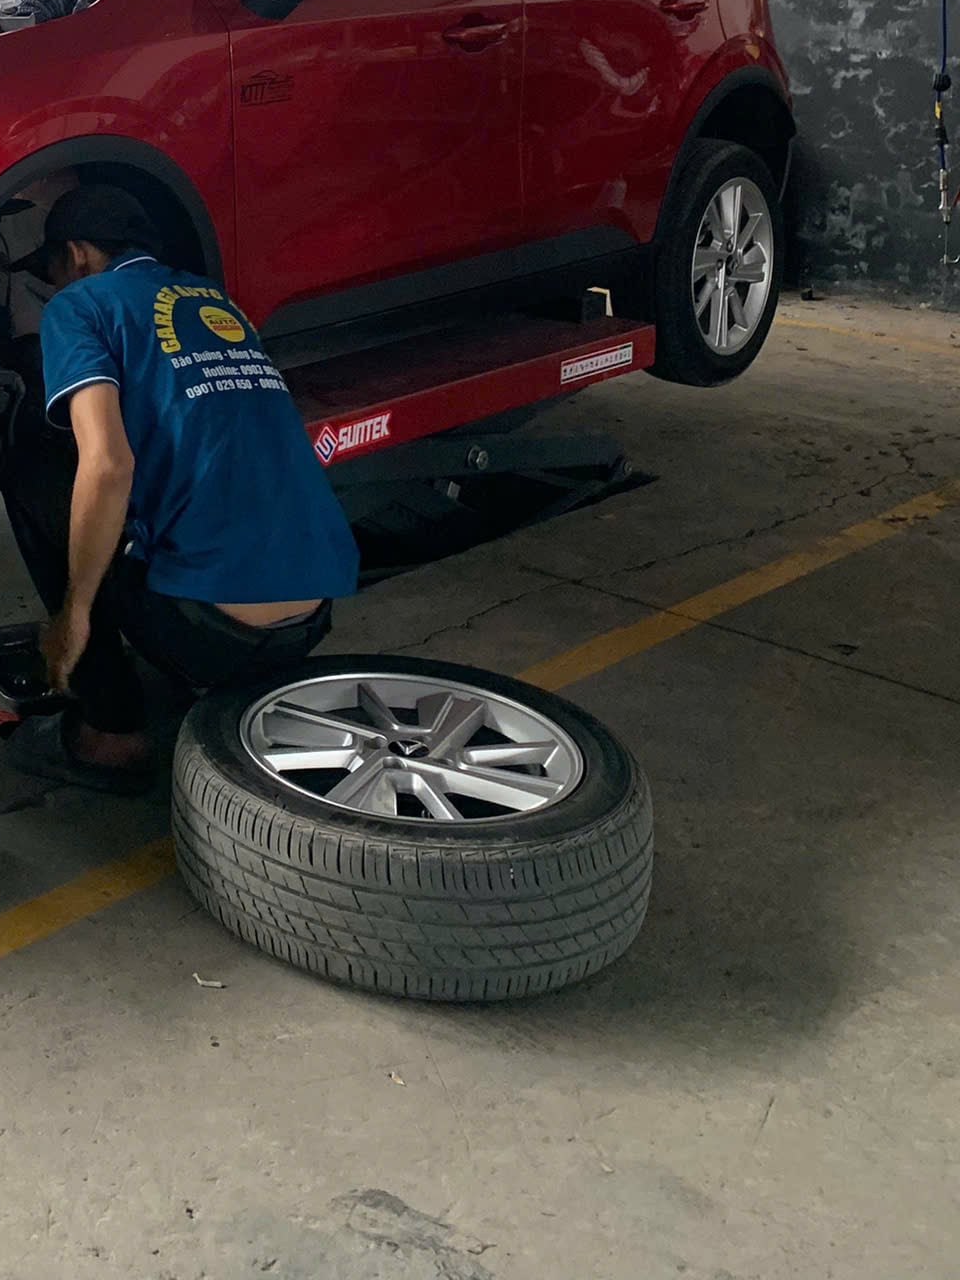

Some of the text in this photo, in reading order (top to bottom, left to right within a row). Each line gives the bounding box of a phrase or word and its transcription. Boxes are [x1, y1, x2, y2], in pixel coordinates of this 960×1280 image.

[153, 286, 182, 353] GARAGE
[170, 355, 193, 369] Bảo
[201, 365, 241, 378] Hotline:
[185, 381, 215, 399] 0901
[337, 412, 392, 452] SUNTEK
